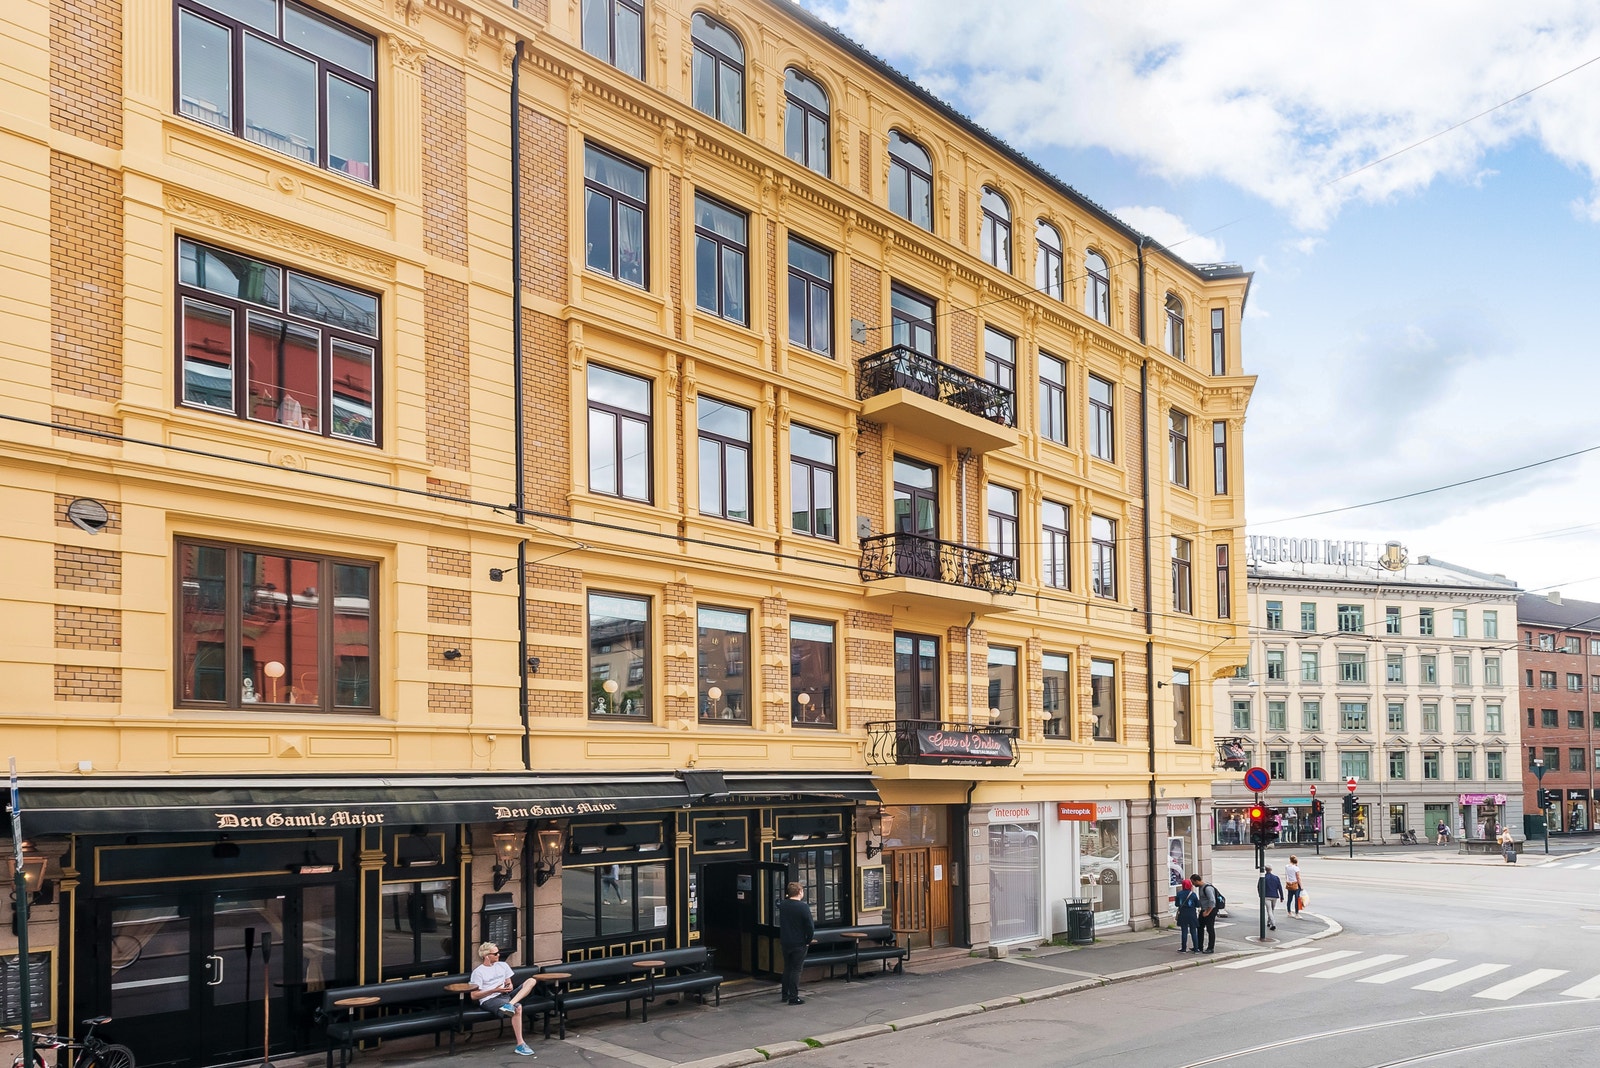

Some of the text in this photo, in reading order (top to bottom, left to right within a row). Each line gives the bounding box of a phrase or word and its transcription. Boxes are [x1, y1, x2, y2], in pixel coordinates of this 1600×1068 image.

[1324, 539, 1368, 566] KAFFE
[928, 732, 1001, 752] Gate of India
[214, 810, 385, 829] Den Gamle Major
[492, 802, 617, 820] Den Gamle Major
